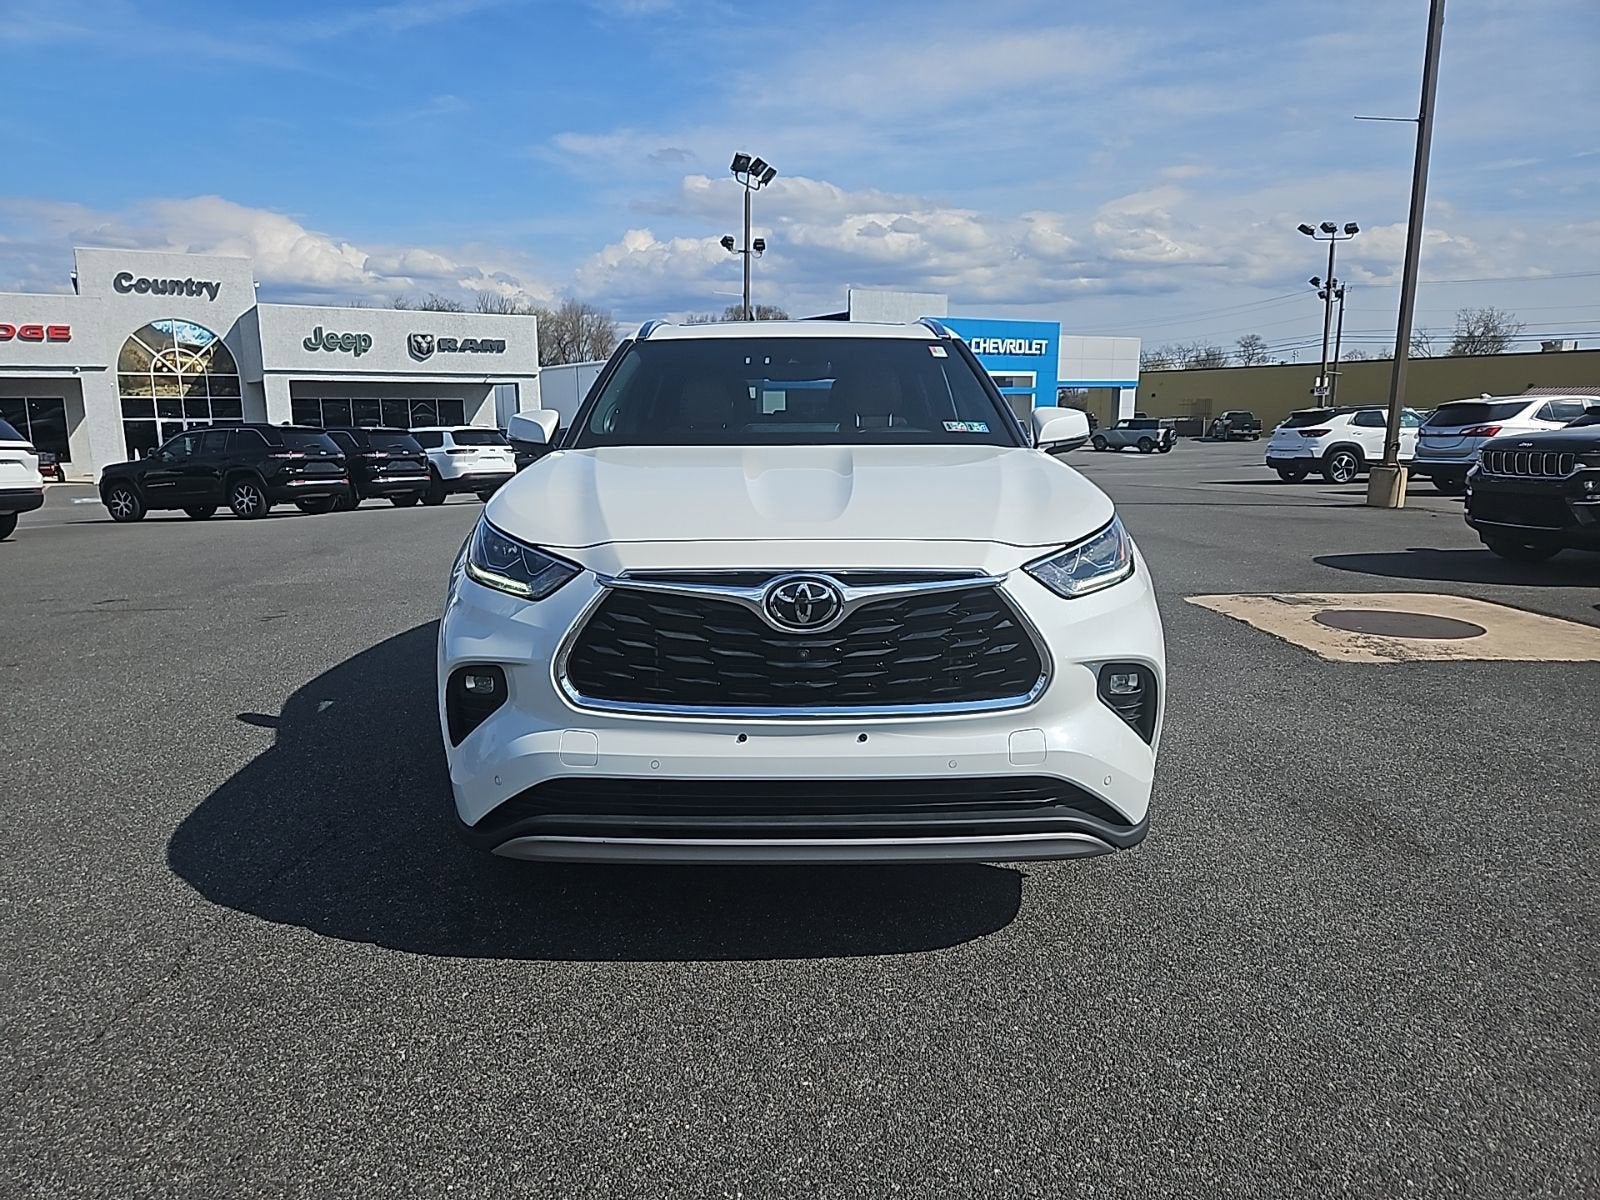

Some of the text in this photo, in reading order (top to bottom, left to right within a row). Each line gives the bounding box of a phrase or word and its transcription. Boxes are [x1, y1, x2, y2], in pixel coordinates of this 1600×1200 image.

[113, 272, 221, 302] Country
[303, 326, 373, 357] Jeep
[437, 338, 506, 353] RAM
[971, 337, 1048, 354] CHEVROLET
